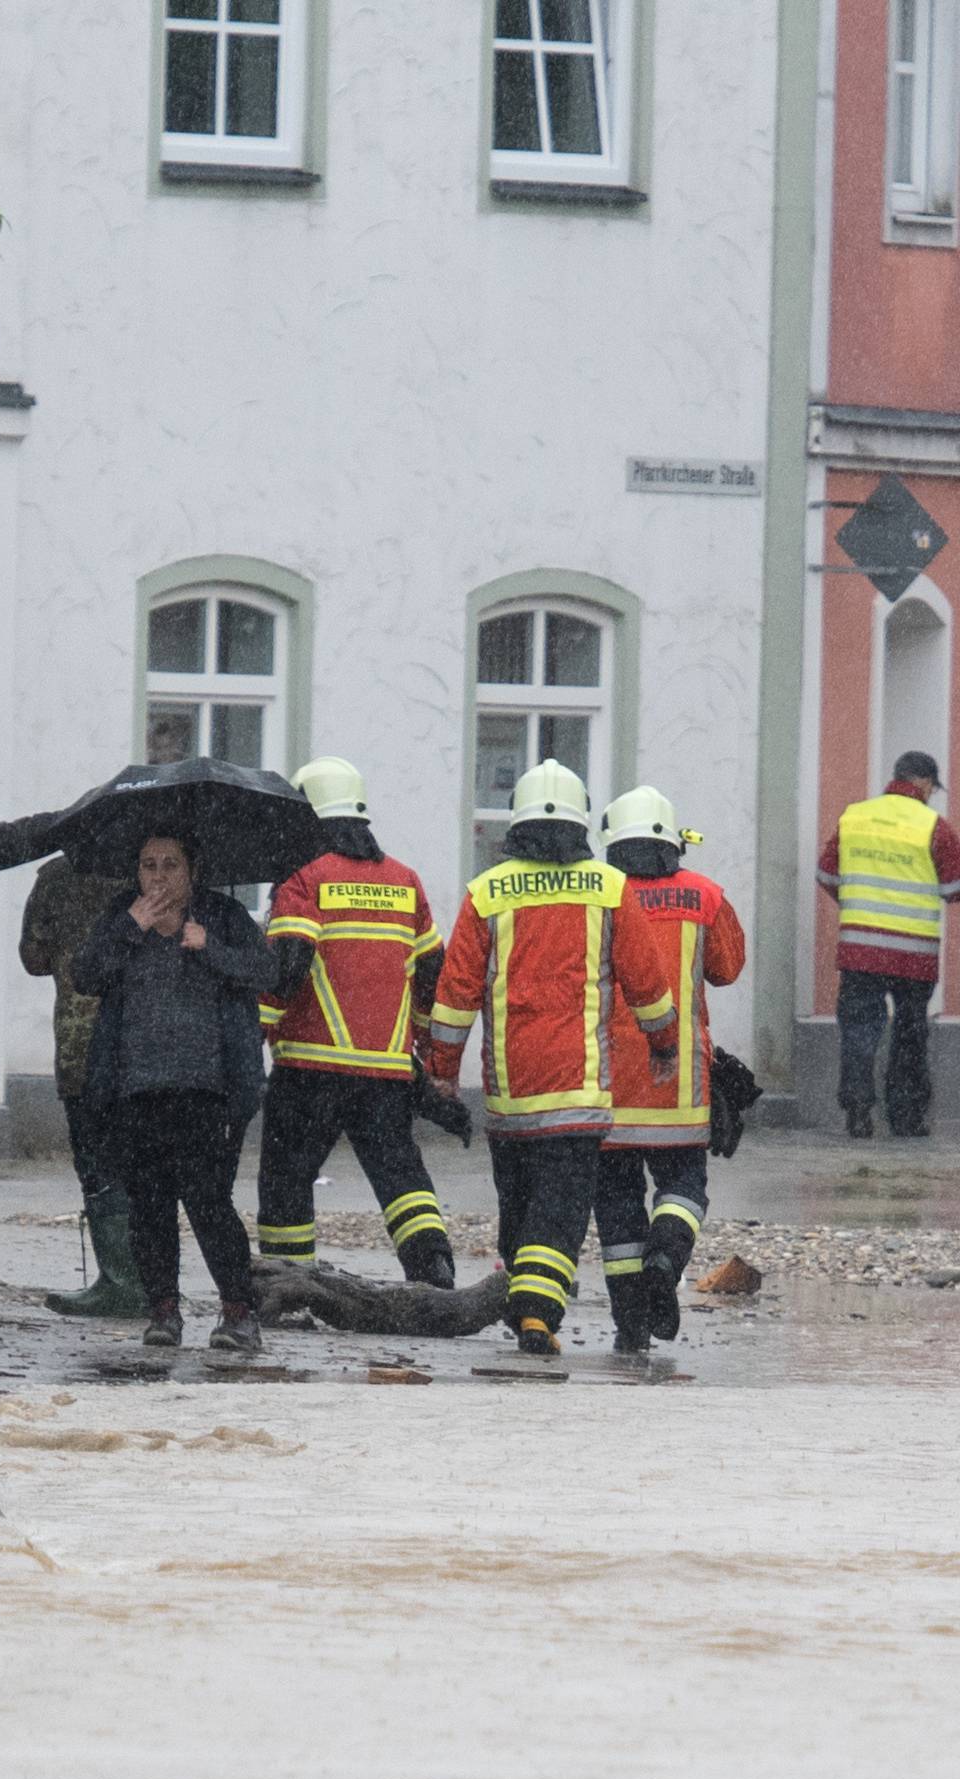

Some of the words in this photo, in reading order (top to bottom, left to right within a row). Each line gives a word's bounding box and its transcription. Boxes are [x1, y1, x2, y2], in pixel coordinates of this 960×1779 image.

[328, 884, 408, 899] FEUERWEHR
[489, 870, 604, 899] FEUERWEHR
[348, 898, 394, 908] TRIFTERN
